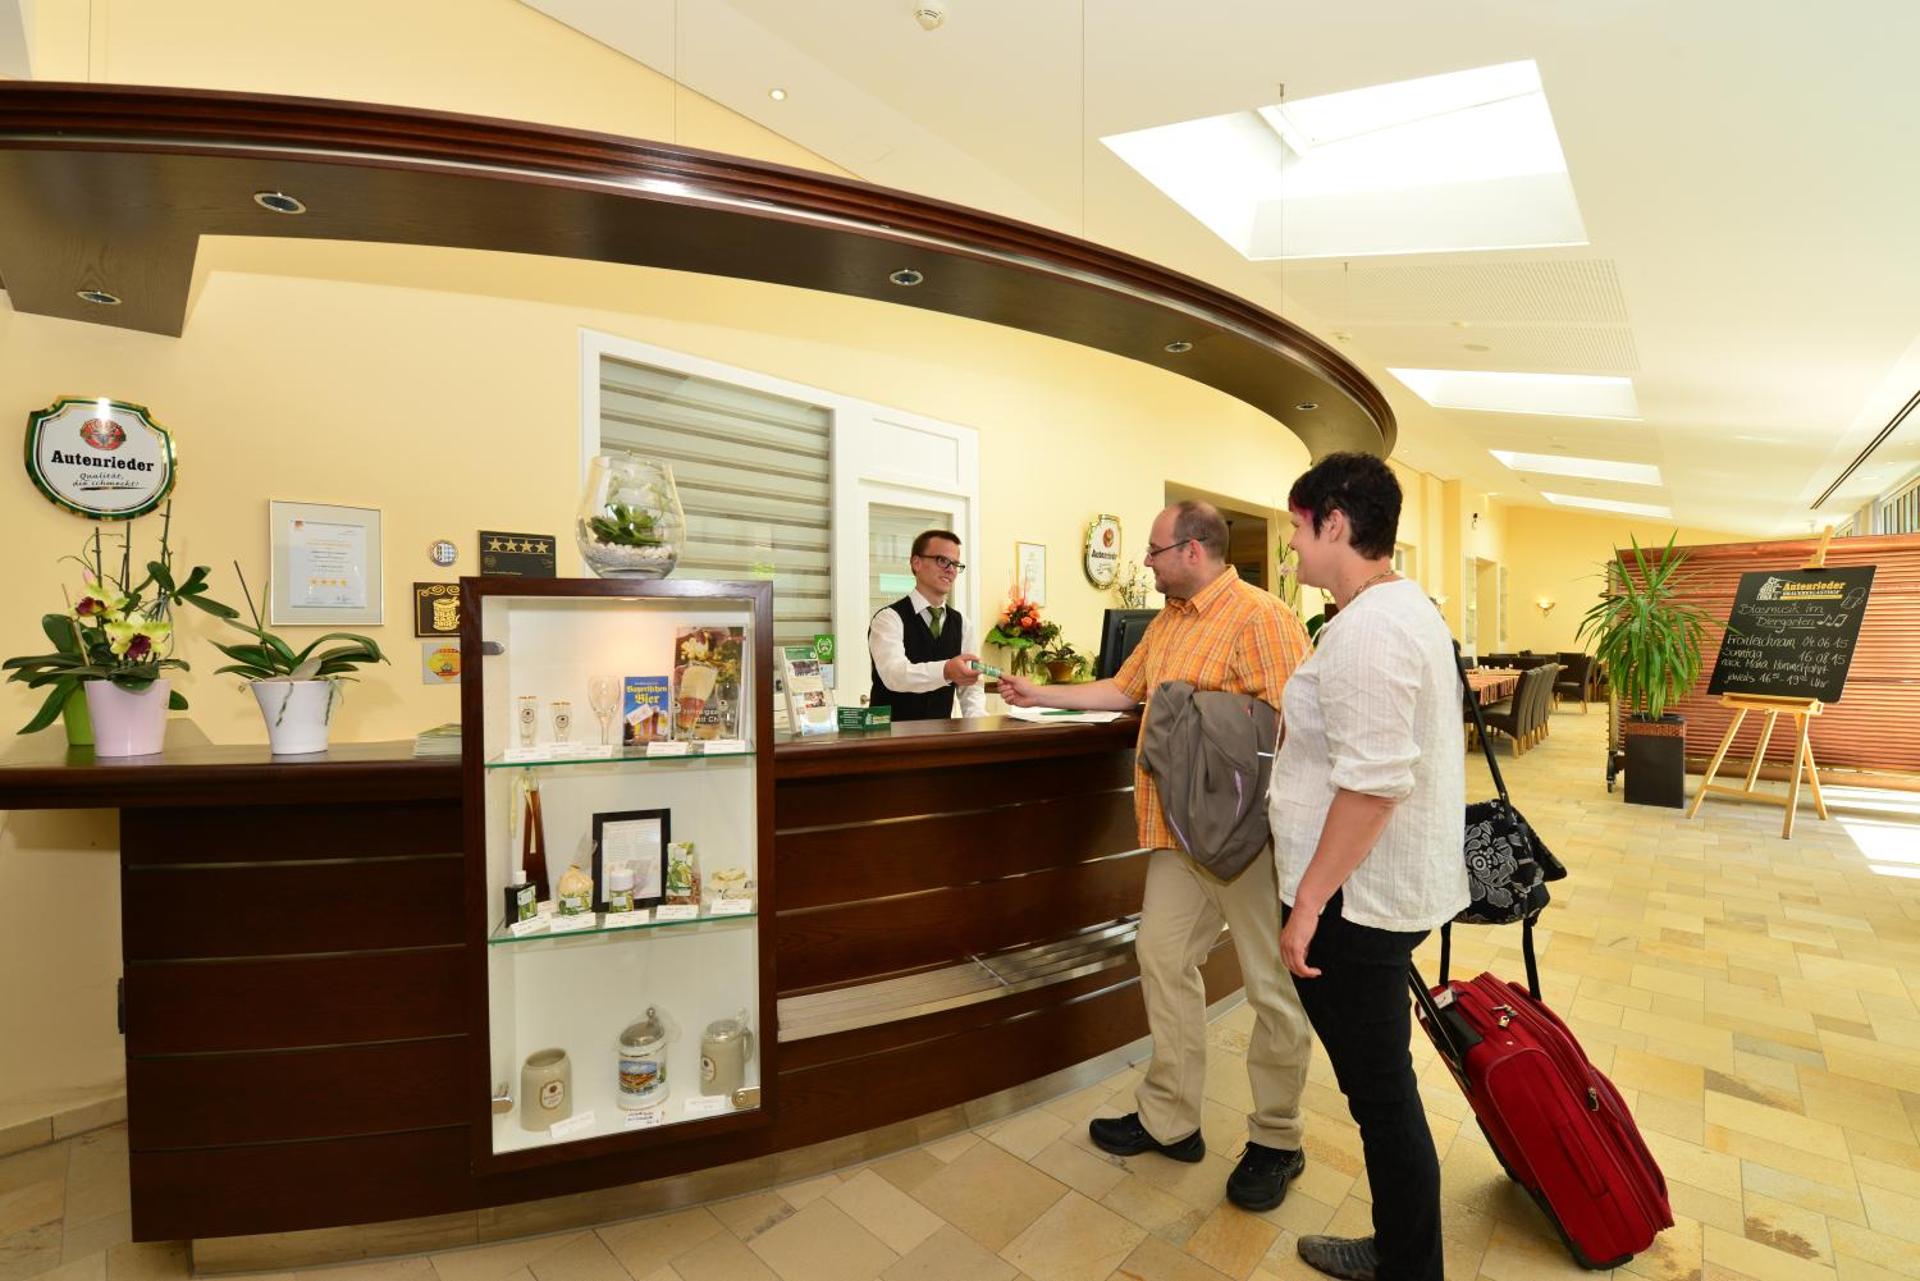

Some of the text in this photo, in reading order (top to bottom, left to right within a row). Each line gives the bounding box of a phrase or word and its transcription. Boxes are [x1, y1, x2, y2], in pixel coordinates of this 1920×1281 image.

[51, 450, 154, 472] Autenrieder
[1782, 581, 1846, 591] Autenrieder
[1738, 602, 1824, 615] Blasmusik im
[1756, 616, 1816, 633] Biergarten
[1722, 647, 1763, 661] Sonntag
[635, 692, 660, 704] Bier
